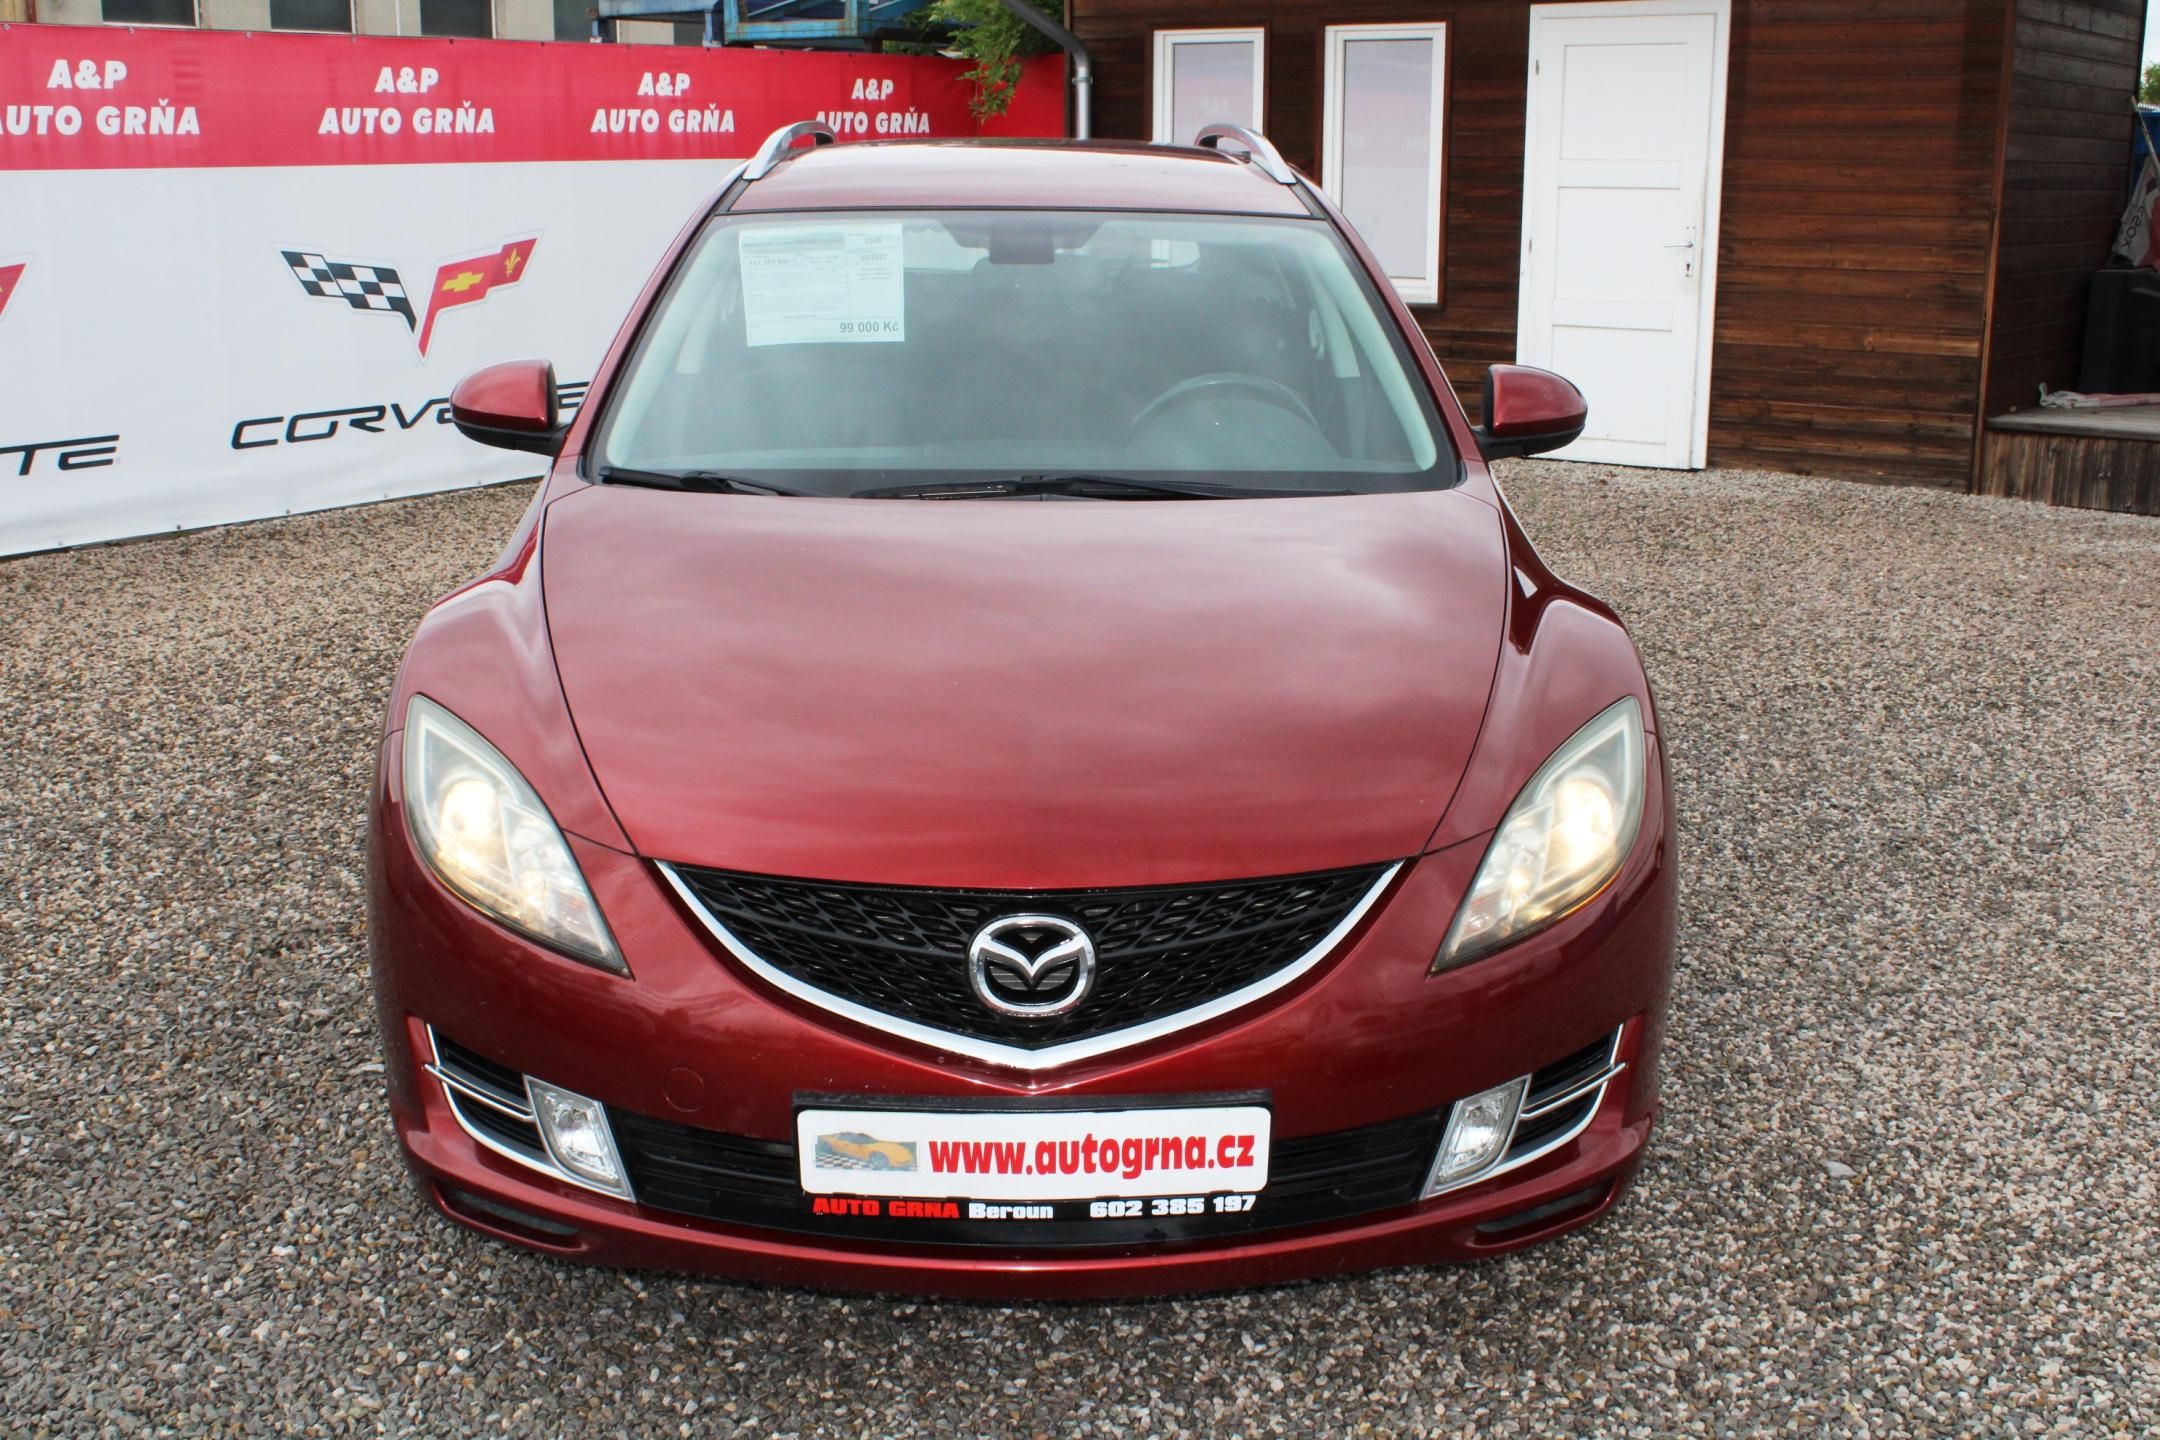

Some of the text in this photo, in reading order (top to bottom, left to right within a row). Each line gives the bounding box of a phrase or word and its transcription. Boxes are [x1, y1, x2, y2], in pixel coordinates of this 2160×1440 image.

[47, 59, 128, 90] A&P
[374, 66, 440, 93] A&P
[637, 72, 691, 97] A&P
[851, 78, 894, 100] A&P
[0, 98, 201, 136] UTO GRŇA
[318, 100, 495, 135] AUTO GRŇA
[590, 103, 735, 134] AUTO GRŇA
[875, 106, 930, 134] GRŇA
[839, 320, 900, 333] 99 000 Kč
[231, 381, 591, 450] CORVE
[929, 1133, 1256, 1180] www.autogrna.cz
[812, 1194, 1257, 1220] AUTO GRNA Beroun 602 385 197
